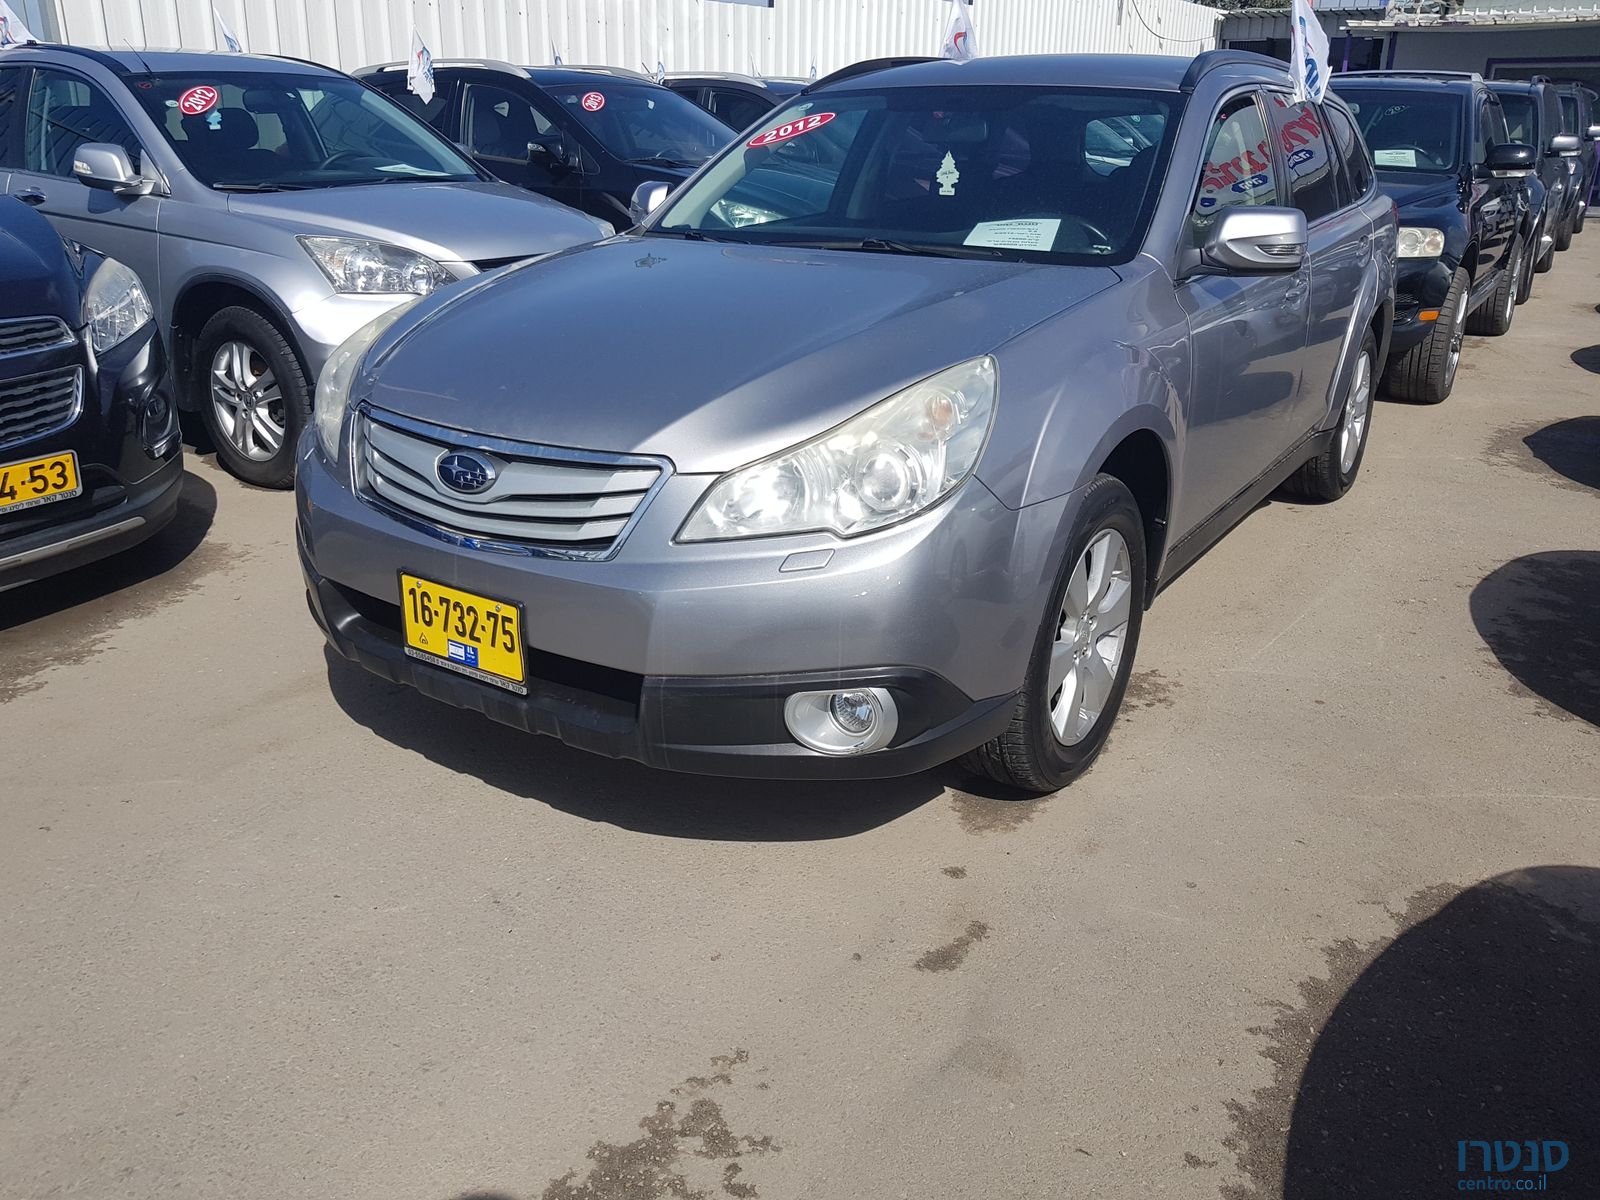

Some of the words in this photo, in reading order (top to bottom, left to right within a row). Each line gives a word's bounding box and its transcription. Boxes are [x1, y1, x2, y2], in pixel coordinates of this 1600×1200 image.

[184, 89, 214, 111] 2012
[763, 116, 822, 143] 2012
[408, 587, 516, 653] 16-732-75
